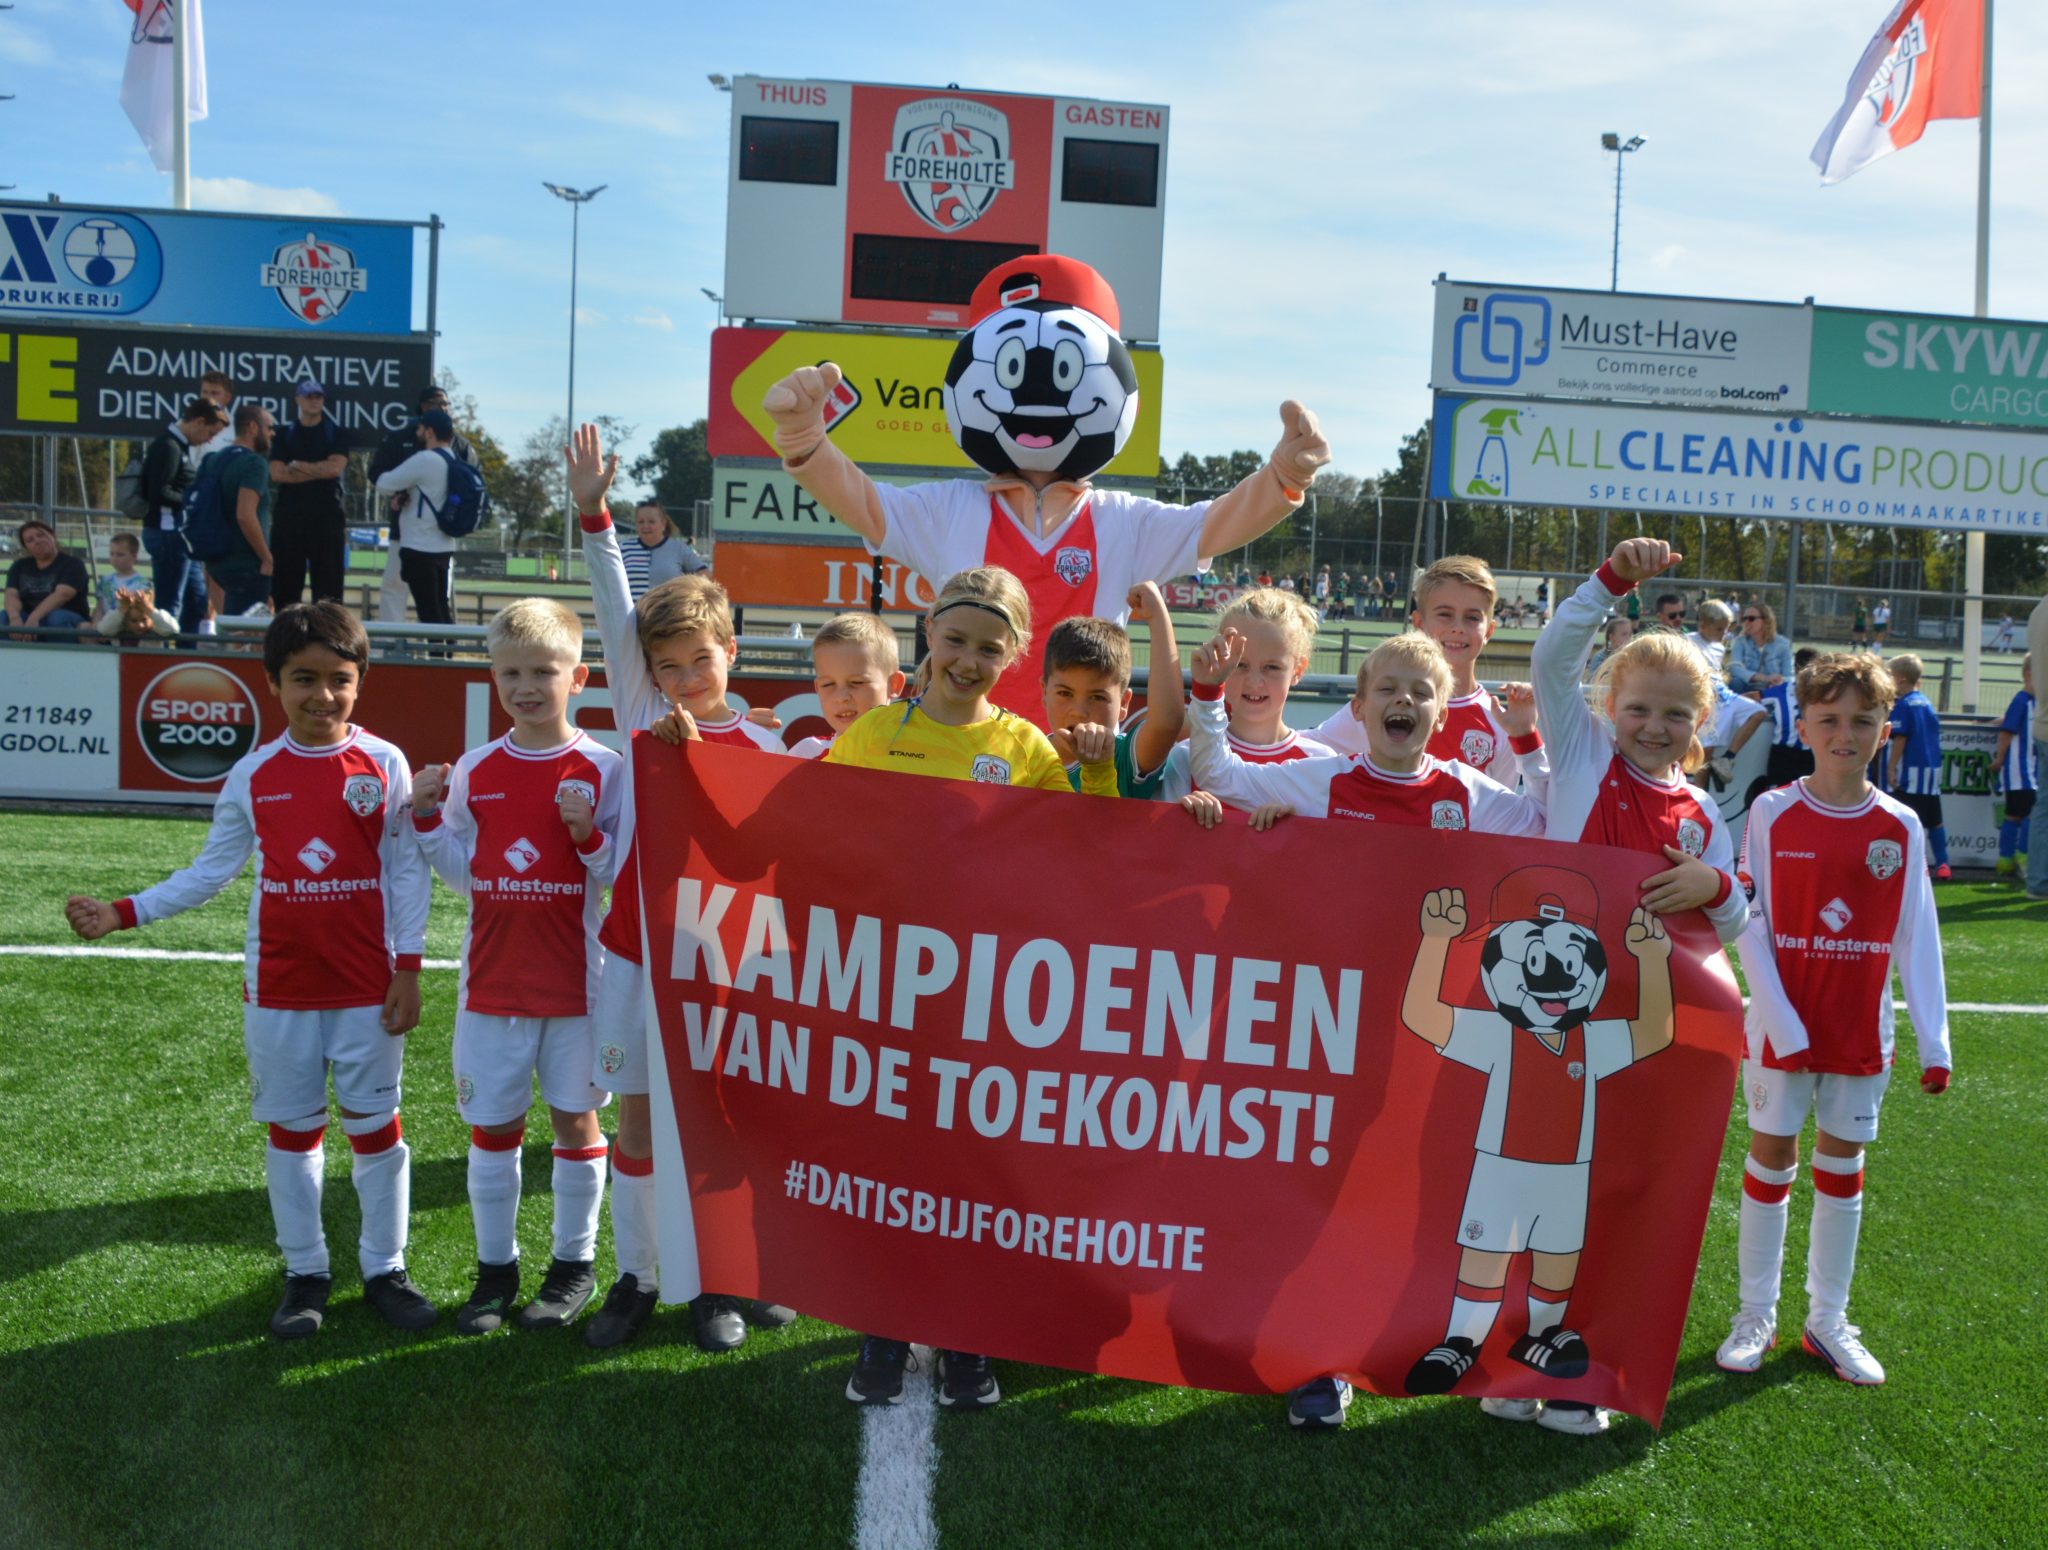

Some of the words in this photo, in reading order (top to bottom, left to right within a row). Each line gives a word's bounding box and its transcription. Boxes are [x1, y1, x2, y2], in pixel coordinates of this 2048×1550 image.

[757, 83, 827, 106] THUIS
[1065, 105, 1161, 130] GASTEN
[892, 155, 1006, 186] FOREHOLTE
[267, 266, 360, 289] FOREHOLTE
[1560, 314, 1738, 353] Must-Have
[1863, 320, 2048, 379] SKYW
[107, 346, 401, 388] ADMINISTRATIEVE
[1596, 357, 1698, 379] Commerce
[875, 378, 944, 410] Van
[1558, 378, 1590, 392] Bekijk
[1592, 382, 1612, 392] ons
[1614, 381, 1660, 396] volledige
[1663, 385, 1702, 397] aanbod
[1704, 388, 1718, 399] op
[1720, 386, 1780, 402] bol.com
[876, 419, 923, 432] GOED
[725, 481, 836, 524] FAR
[1589, 484, 1735, 507] SPECIALIST
[1752, 494, 1774, 509] IN
[1790, 497, 2048, 527] SCHOONMAAKARTIKE
[4, 705, 93, 726] 211849
[150, 700, 246, 723] SPORT
[0, 733, 110, 755] GDOL.NL
[159, 723, 237, 746] 2000
[888, 750, 925, 759] STANNO
[1334, 807, 1376, 821] STANNO
[262, 878, 288, 893] Van
[294, 878, 379, 894] Kesteren
[498, 876, 583, 895] Kesteren
[286, 894, 351, 903] SCHILDERS
[490, 894, 552, 902] SCHILDERS
[1775, 933, 1807, 950] Van
[1813, 936, 1892, 955] Kesteren
[1803, 951, 1861, 961] SCHILDERS
[670, 877, 1364, 1076] KAMPIOENEN
[681, 1001, 812, 1096] VAN
[829, 1036, 911, 1121] DE
[929, 1057, 1335, 1167] TOEKOMST!
[784, 1160, 1205, 1273] #DATISBIJFOREHOLTE
